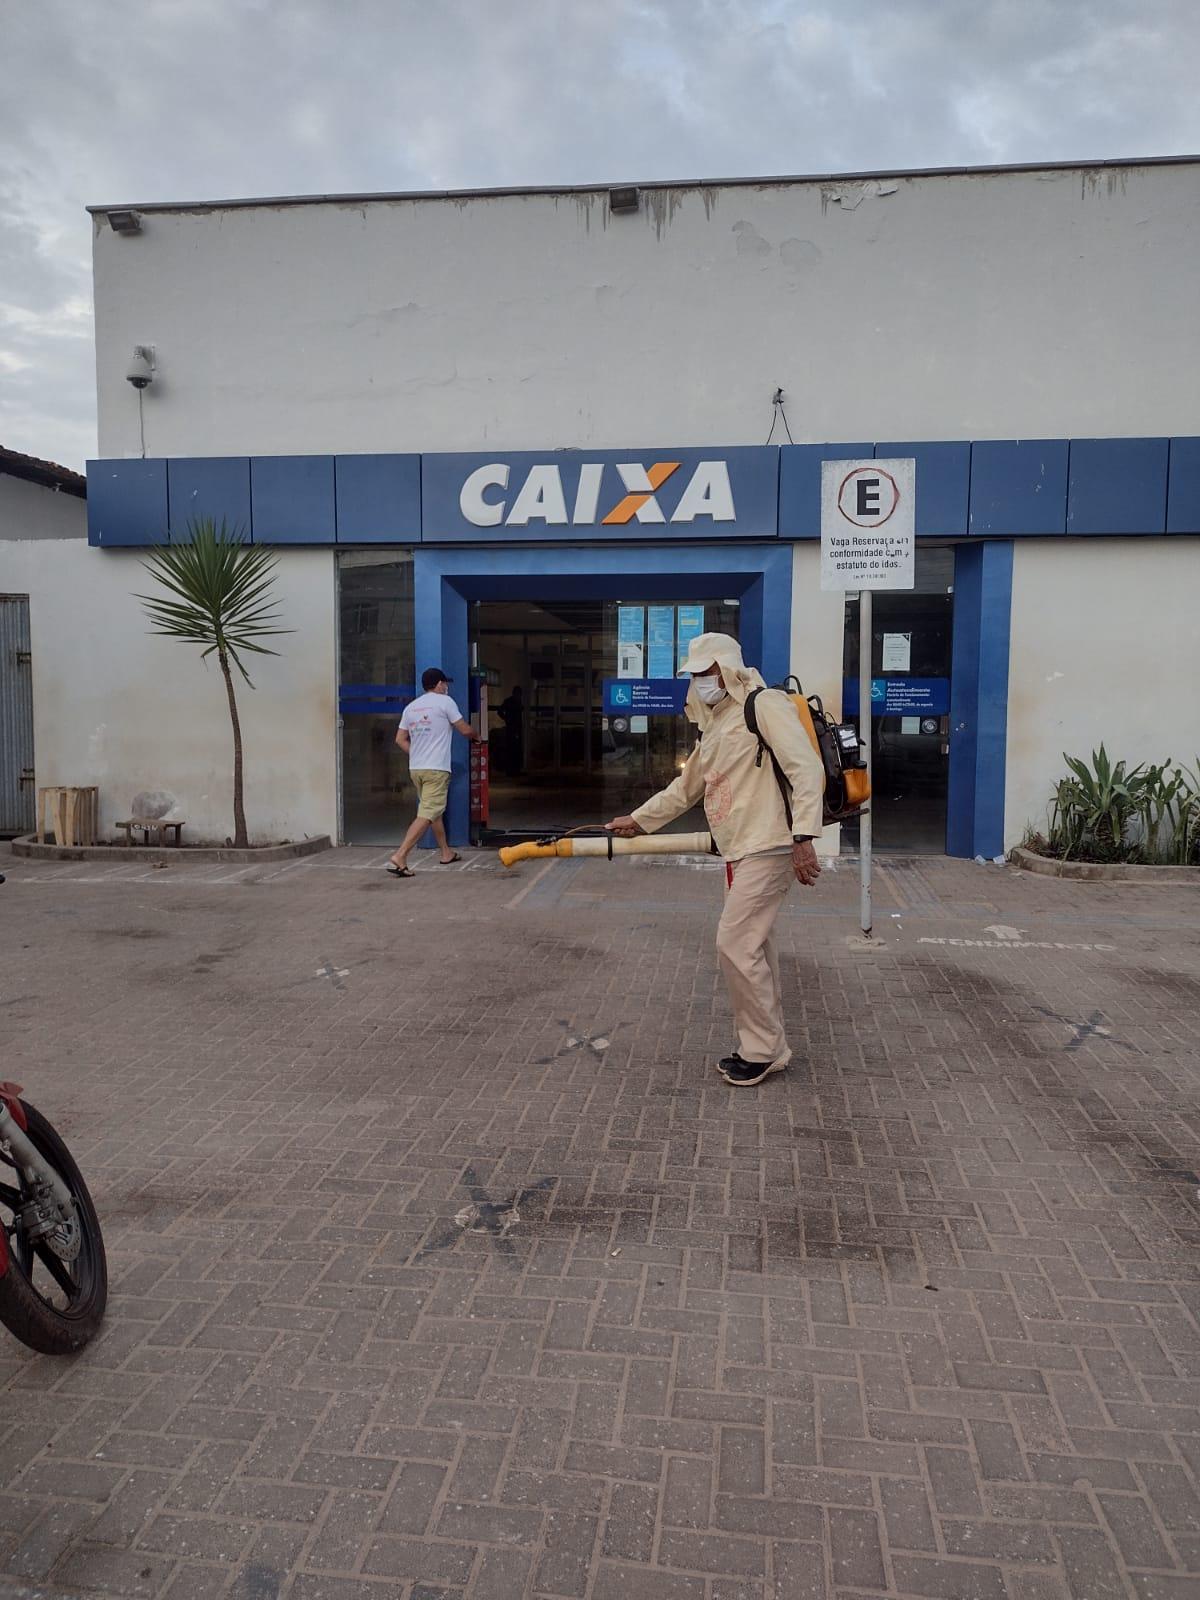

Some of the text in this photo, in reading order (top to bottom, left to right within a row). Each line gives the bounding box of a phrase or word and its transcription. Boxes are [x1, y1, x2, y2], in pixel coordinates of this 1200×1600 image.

[459, 461, 737, 527] CAIXA
[856, 479, 880, 515] E
[830, 537, 850, 547] Vaga
[829, 549, 883, 558] conformidade
[885, 549, 902, 557] cm
[836, 560, 902, 569] estatuto do idos
